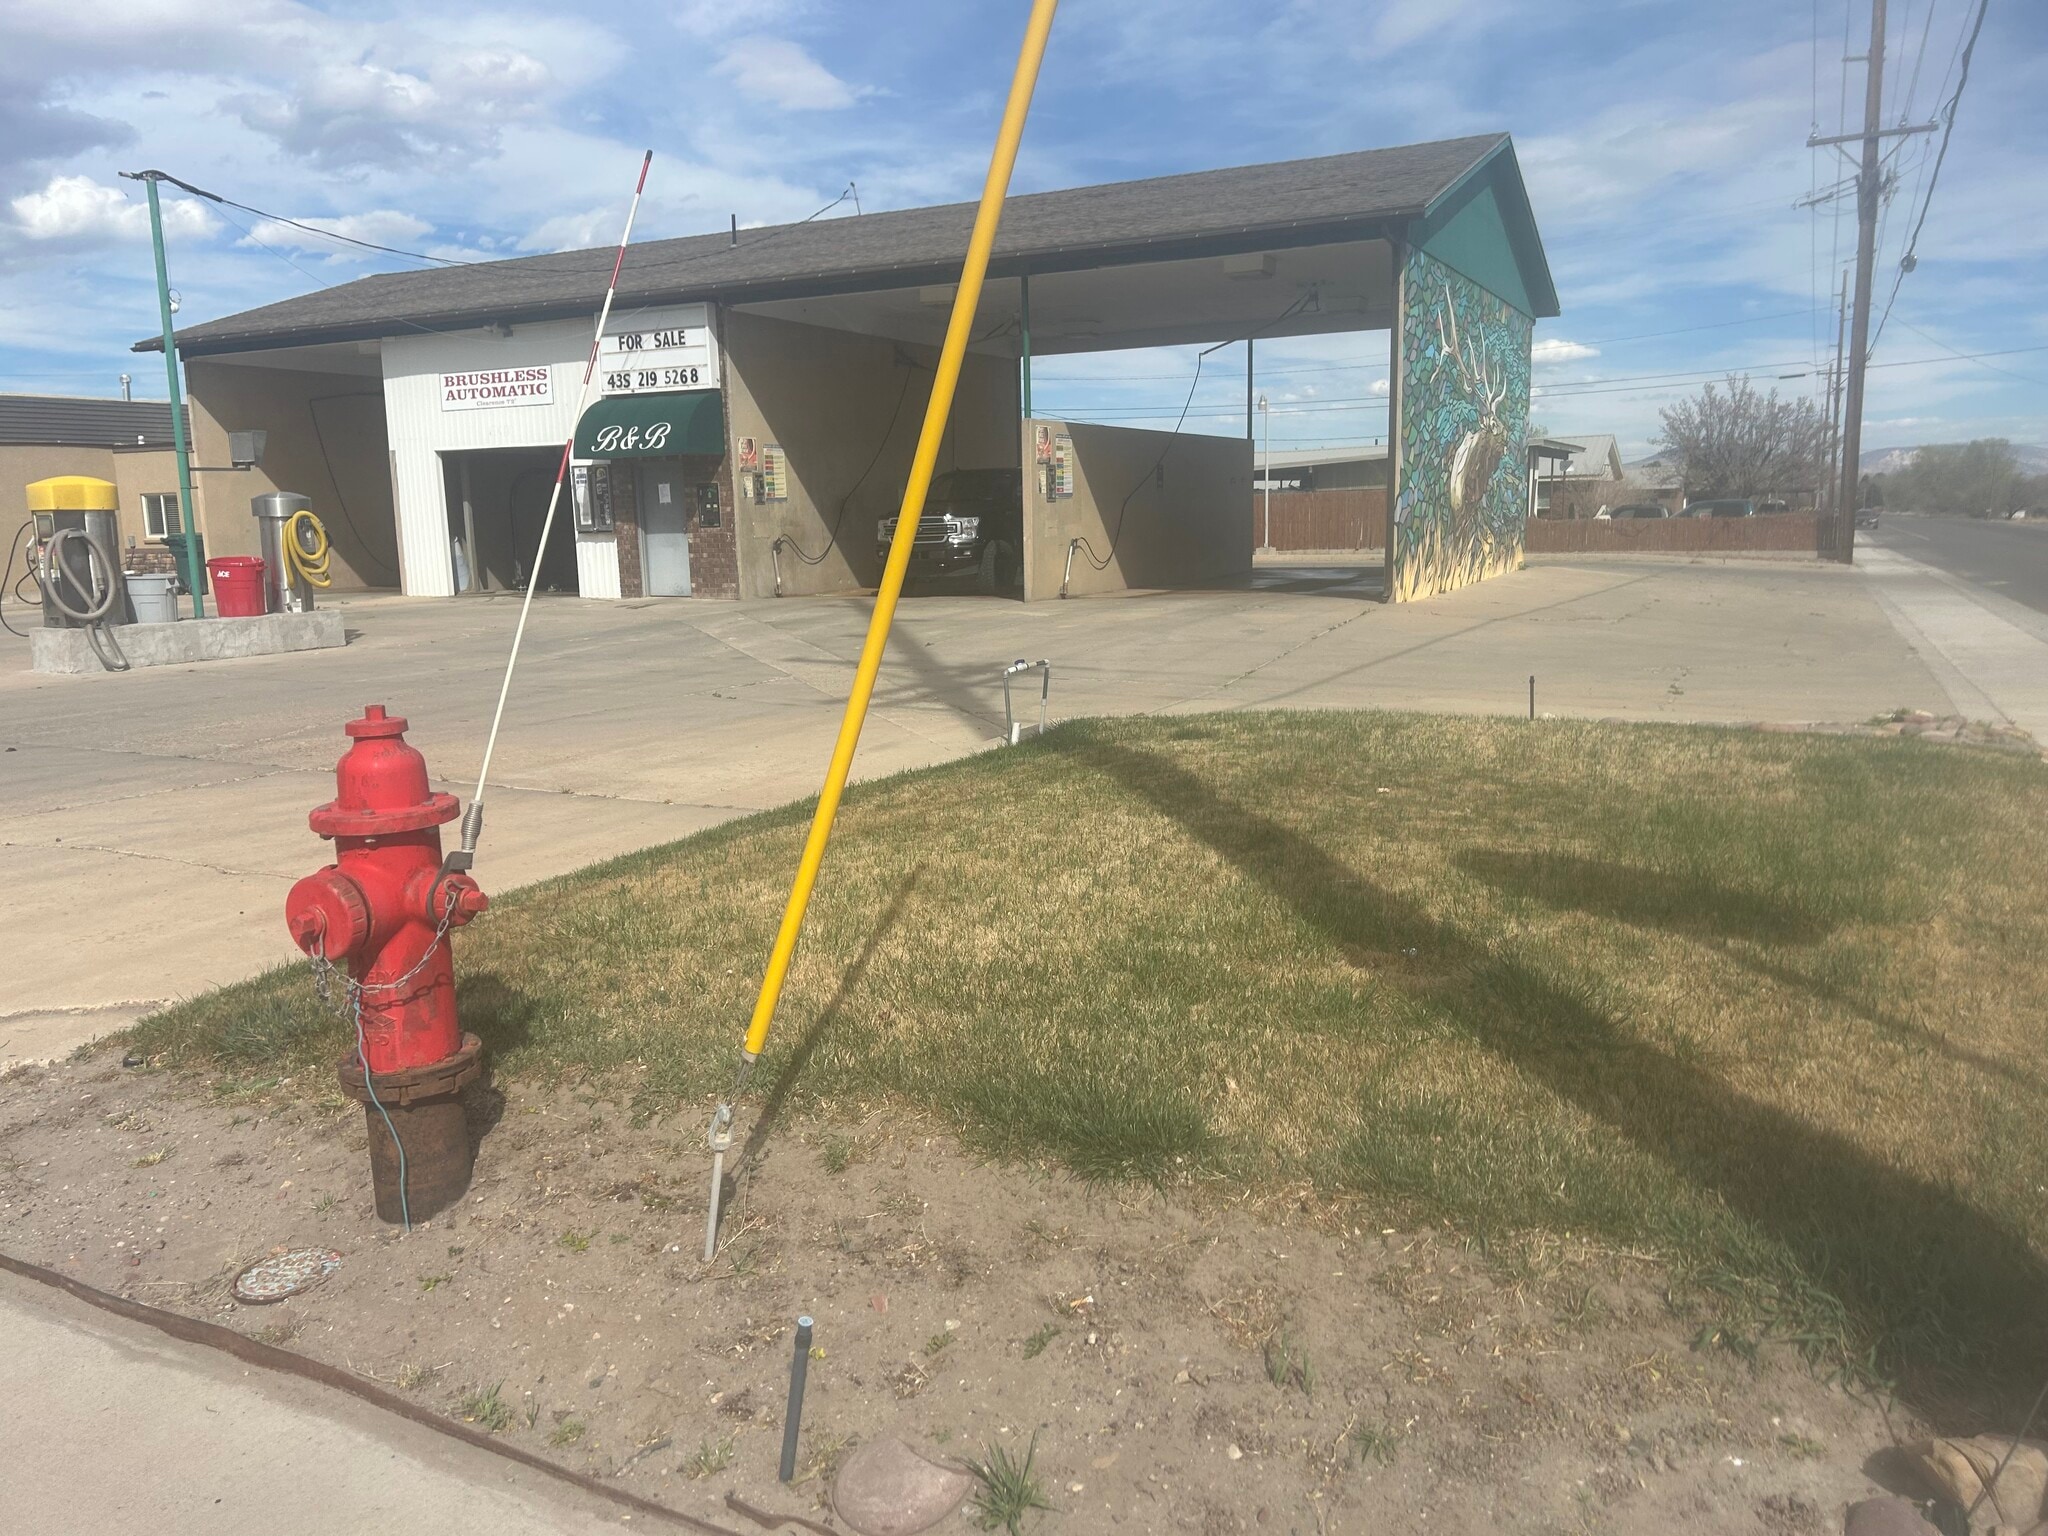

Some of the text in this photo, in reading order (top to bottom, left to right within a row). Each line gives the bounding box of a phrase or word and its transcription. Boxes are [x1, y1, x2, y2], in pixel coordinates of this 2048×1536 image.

[618, 330, 686, 350] FOR SALE
[443, 368, 547, 387] BRUSHLESS
[638, 371, 657, 387] 219
[664, 368, 699, 385] 5268
[445, 383, 548, 401] AUTOMATIC
[590, 422, 671, 452] B&B
[217, 570, 230, 578] ACE
